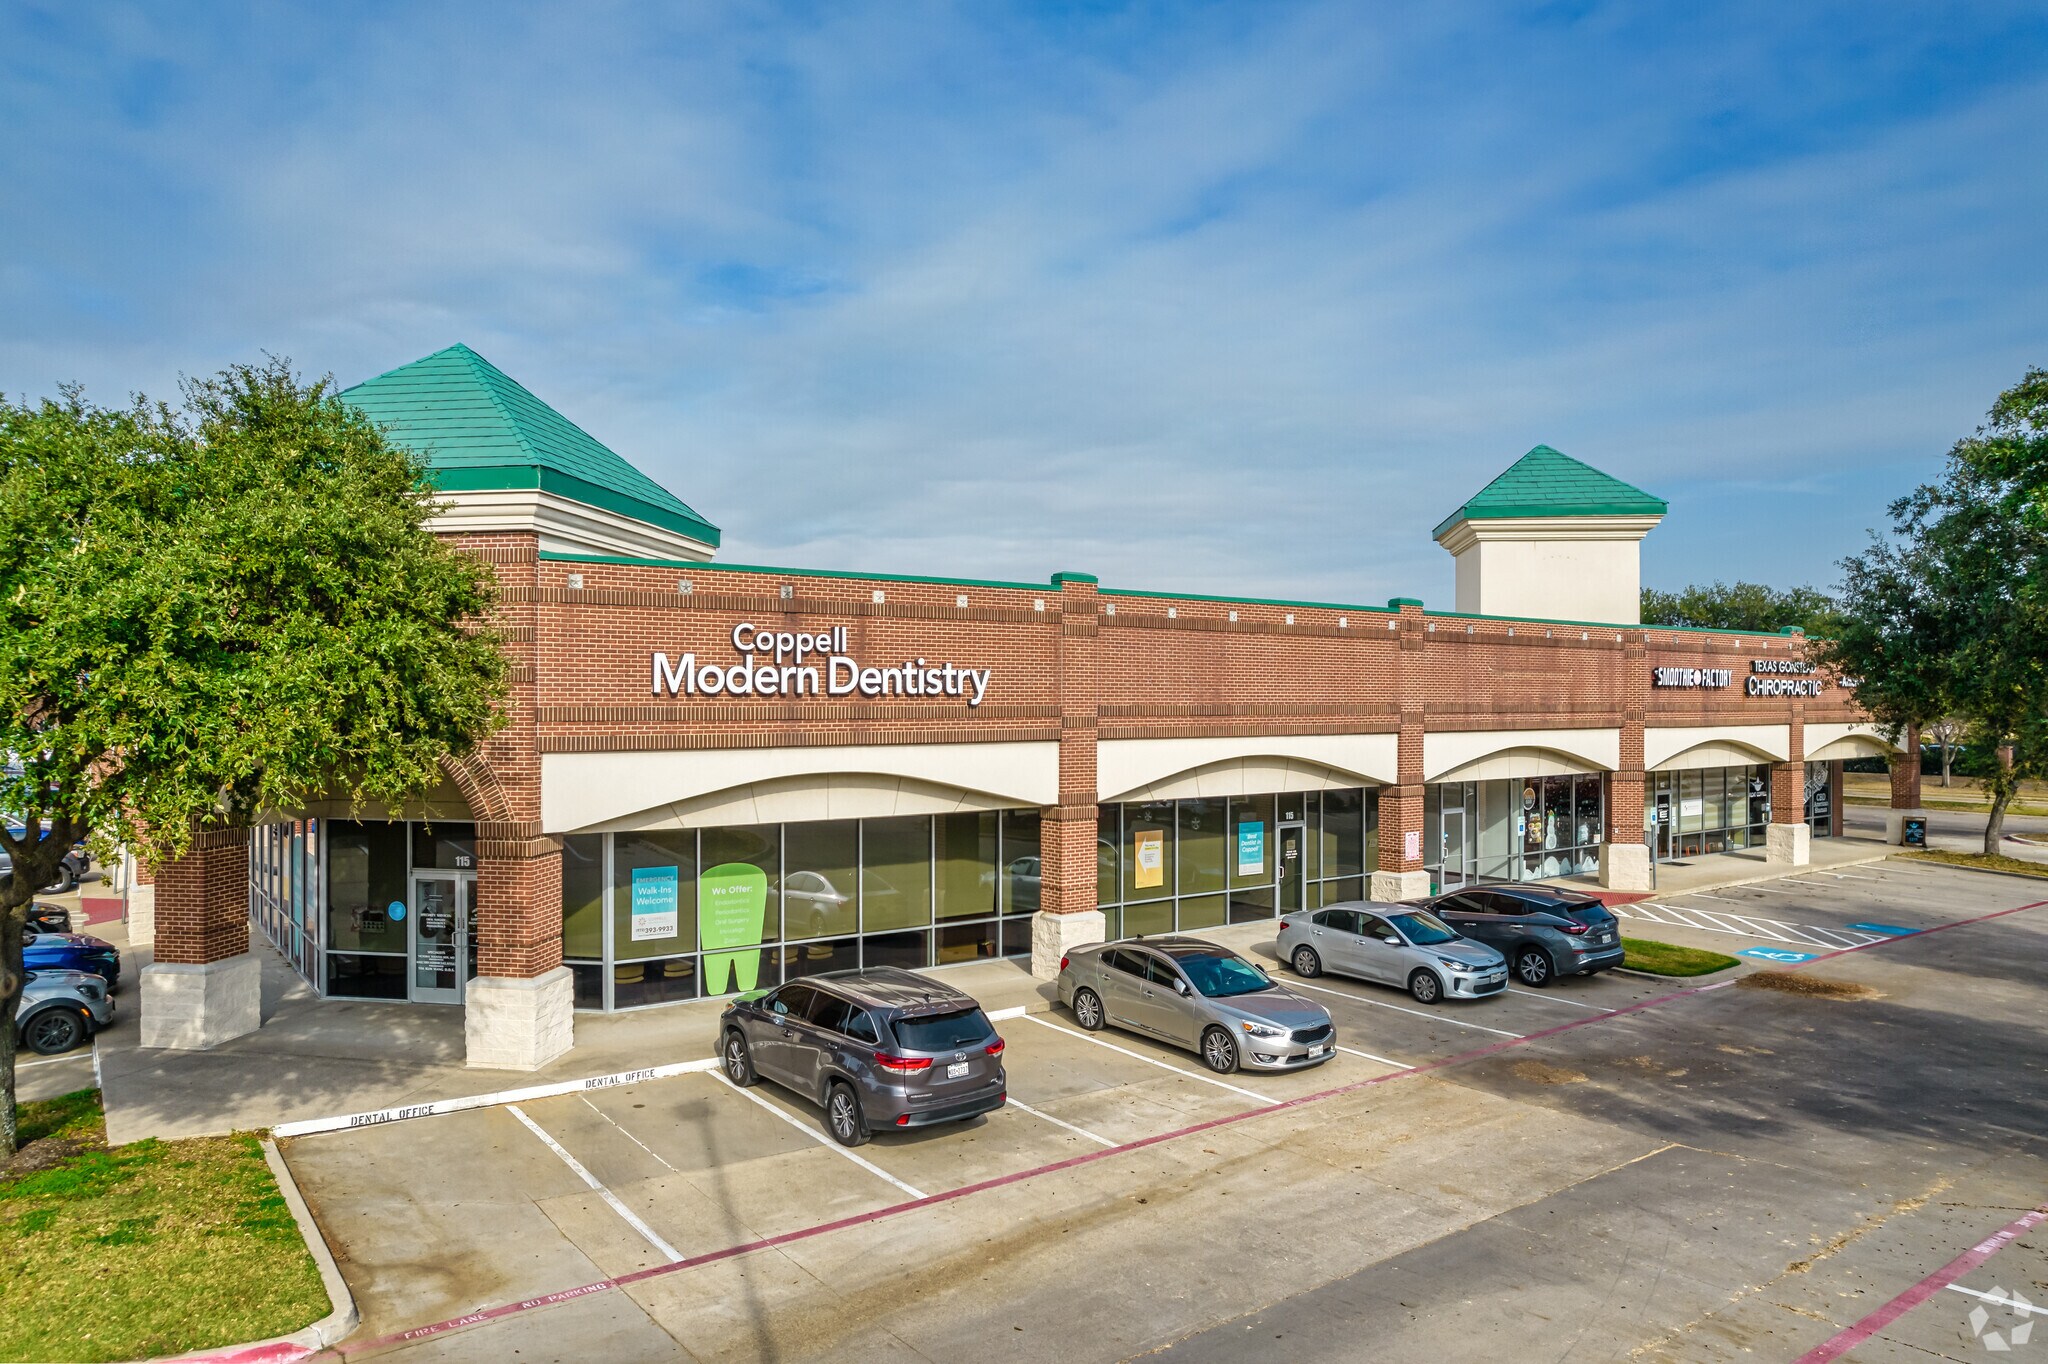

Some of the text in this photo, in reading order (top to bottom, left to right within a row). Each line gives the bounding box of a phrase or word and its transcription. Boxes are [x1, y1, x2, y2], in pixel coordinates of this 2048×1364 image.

[732, 622, 848, 664] Coppell
[1755, 660, 1777, 673] TEXAS
[652, 652, 991, 706] Modern Dentistry
[1657, 668, 1733, 687] SMOOTHIE FACTORY
[1748, 676, 1823, 697] CHIROPRACTIC
[1285, 811, 1294, 820] 115
[455, 856, 470, 867] 115
[637, 886, 672, 896] Walk-Ins
[711, 884, 753, 896] We Offer:
[636, 897, 674, 906] Welcome
[585, 1068, 656, 1089] DENTAL OFFICE
[350, 1105, 434, 1126] DENTAL OFFICE
[403, 1282, 607, 1340] FIRE LANE NO PARKING
